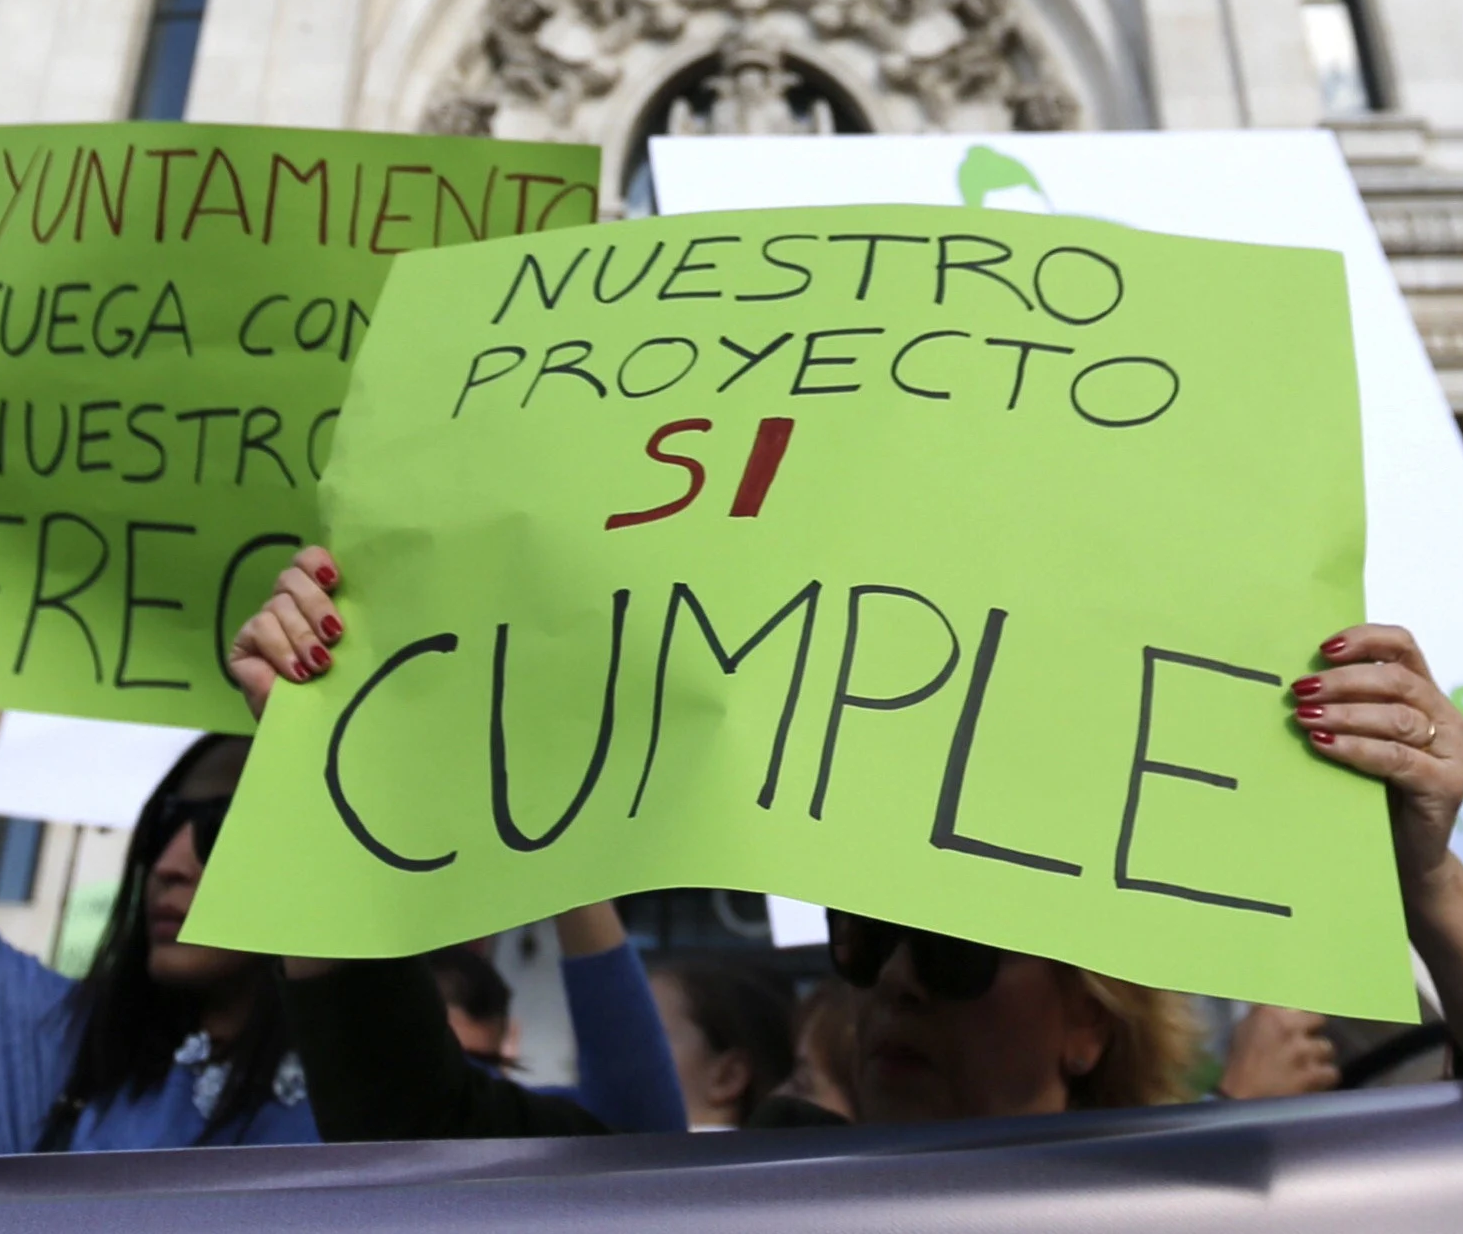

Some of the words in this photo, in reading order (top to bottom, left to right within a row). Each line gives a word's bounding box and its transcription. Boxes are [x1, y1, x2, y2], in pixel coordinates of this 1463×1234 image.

[491, 233, 1124, 326] NUESTRO
[452, 327, 1181, 427] PROYECTO
[604, 416, 795, 530] SI
[326, 580, 1294, 918] CUMPLE
